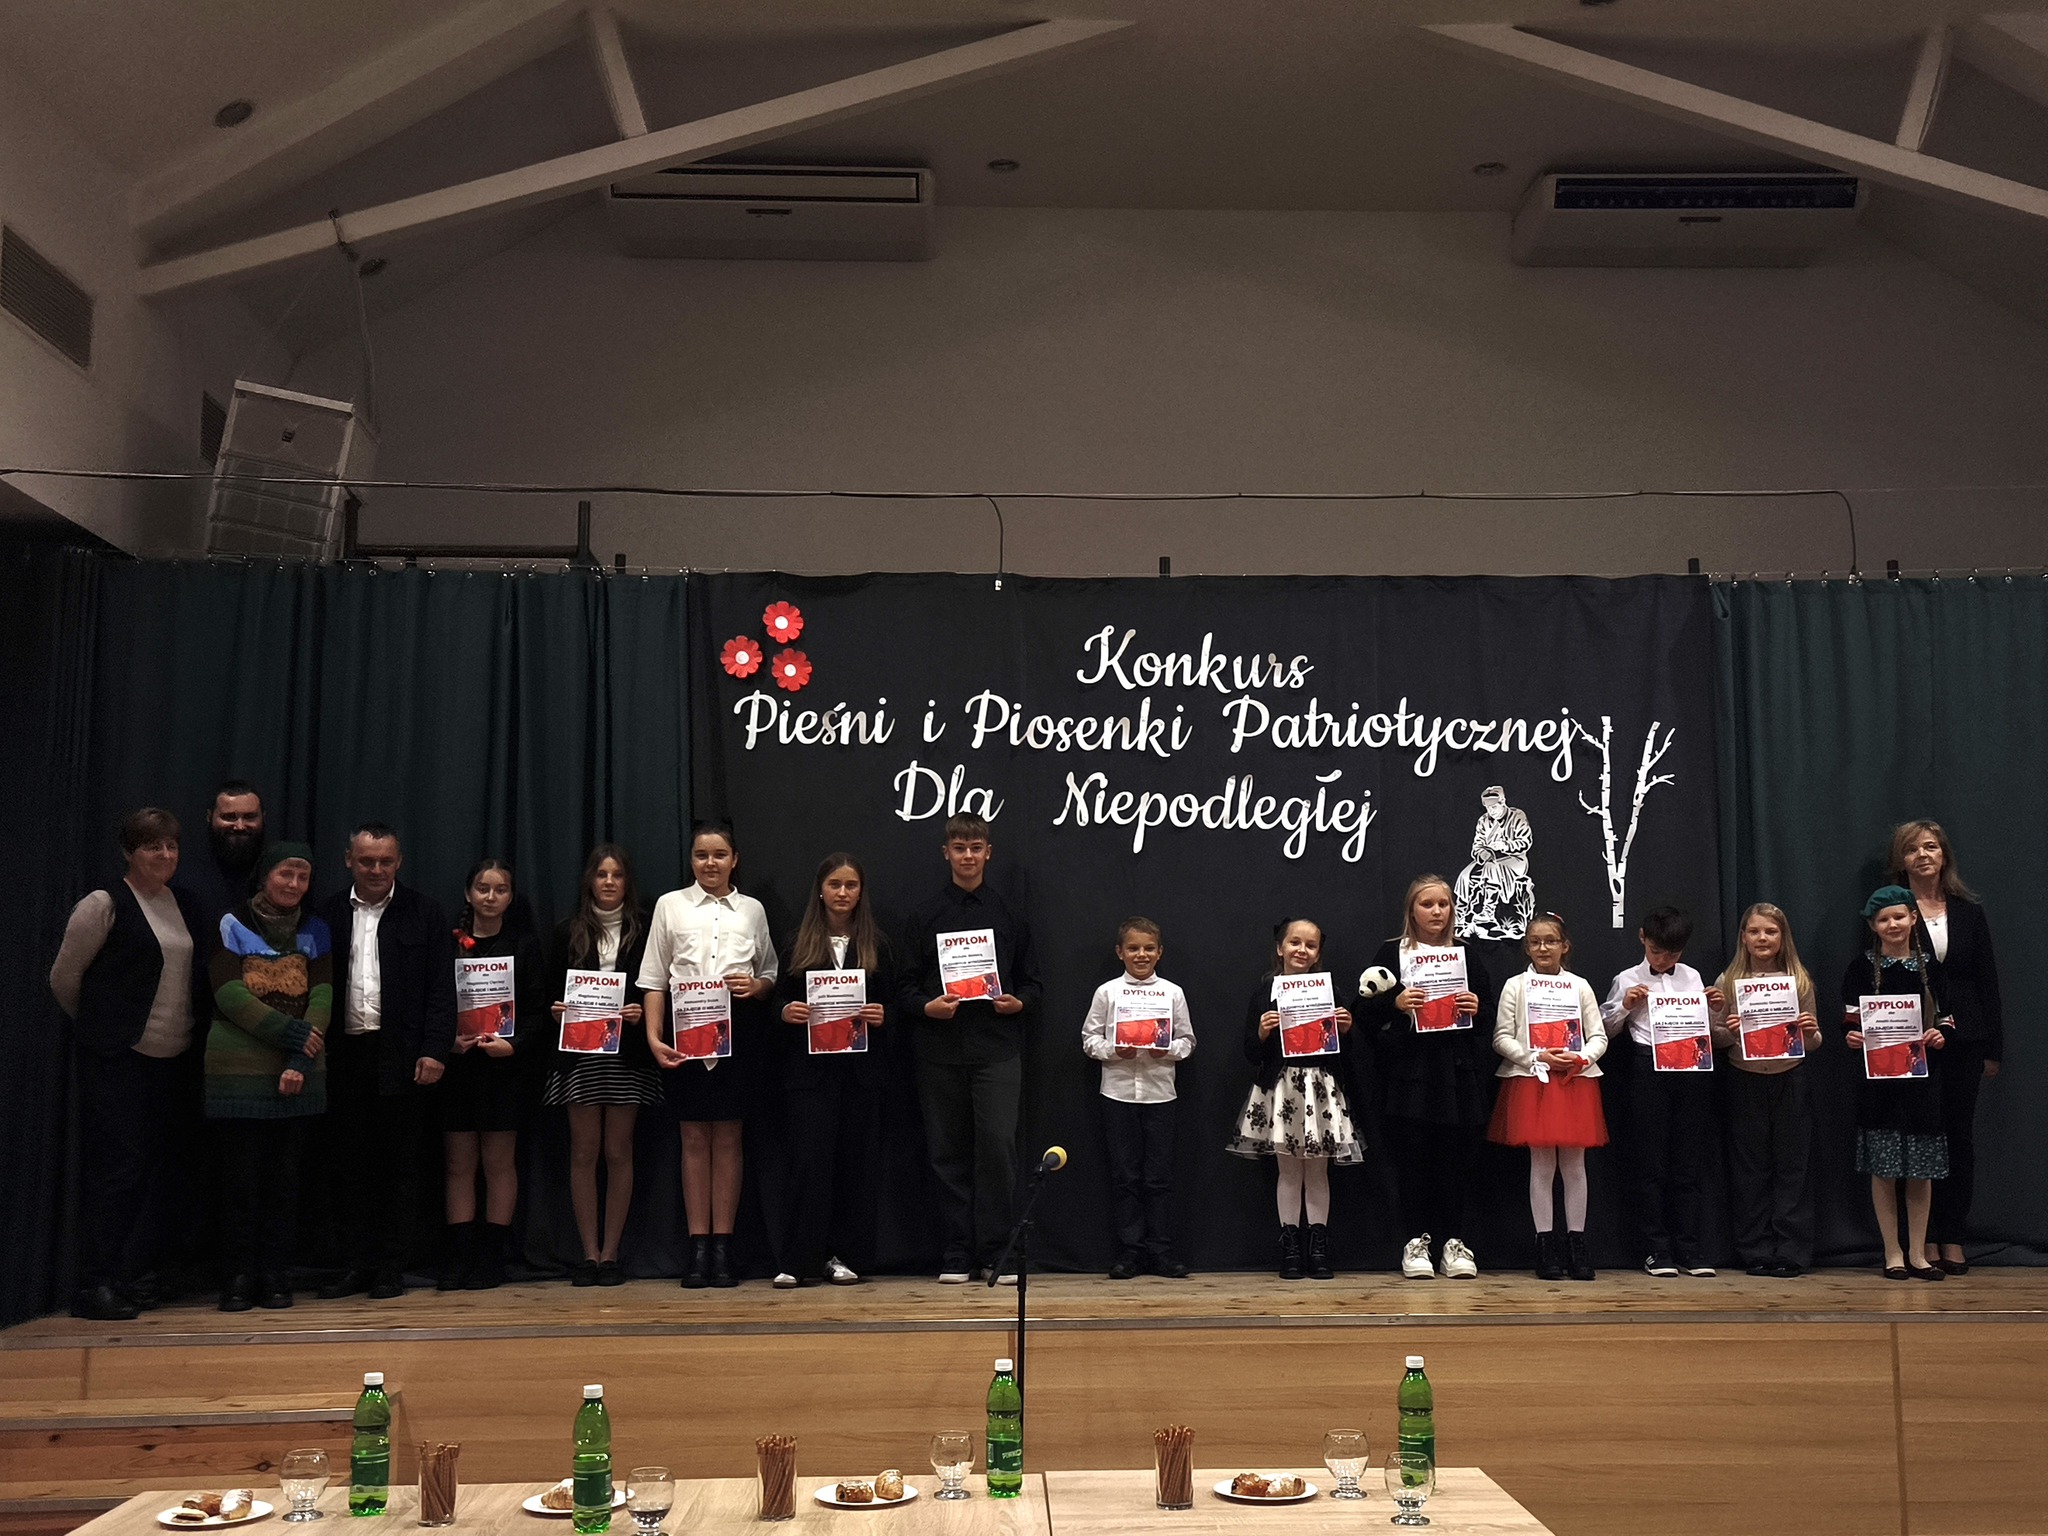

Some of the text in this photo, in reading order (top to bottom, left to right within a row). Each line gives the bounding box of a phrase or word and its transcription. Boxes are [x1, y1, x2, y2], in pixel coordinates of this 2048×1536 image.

[1077, 625, 1314, 692] Konkurs
[733, 688, 1577, 782] Pieśni i Piosenki Patriotycznej
[893, 759, 1378, 863] Dla Niepodległej
[945, 936, 987, 946] DYPLOM
[1416, 953, 1457, 964] DYPLOM
[464, 962, 508, 972] DYPLOM
[575, 976, 619, 986] DYPLOM
[679, 981, 723, 991] DYPLOM
[814, 976, 858, 986] DYPLOM
[1283, 979, 1325, 990] DYPLOM
[1531, 979, 1571, 989] DYPLOM
[1123, 989, 1165, 997] DYPLOM
[1745, 983, 1789, 993] DYPLOM
[1657, 998, 1700, 1006] DYPLOM
[1869, 1001, 1914, 1010] DYPLOM
